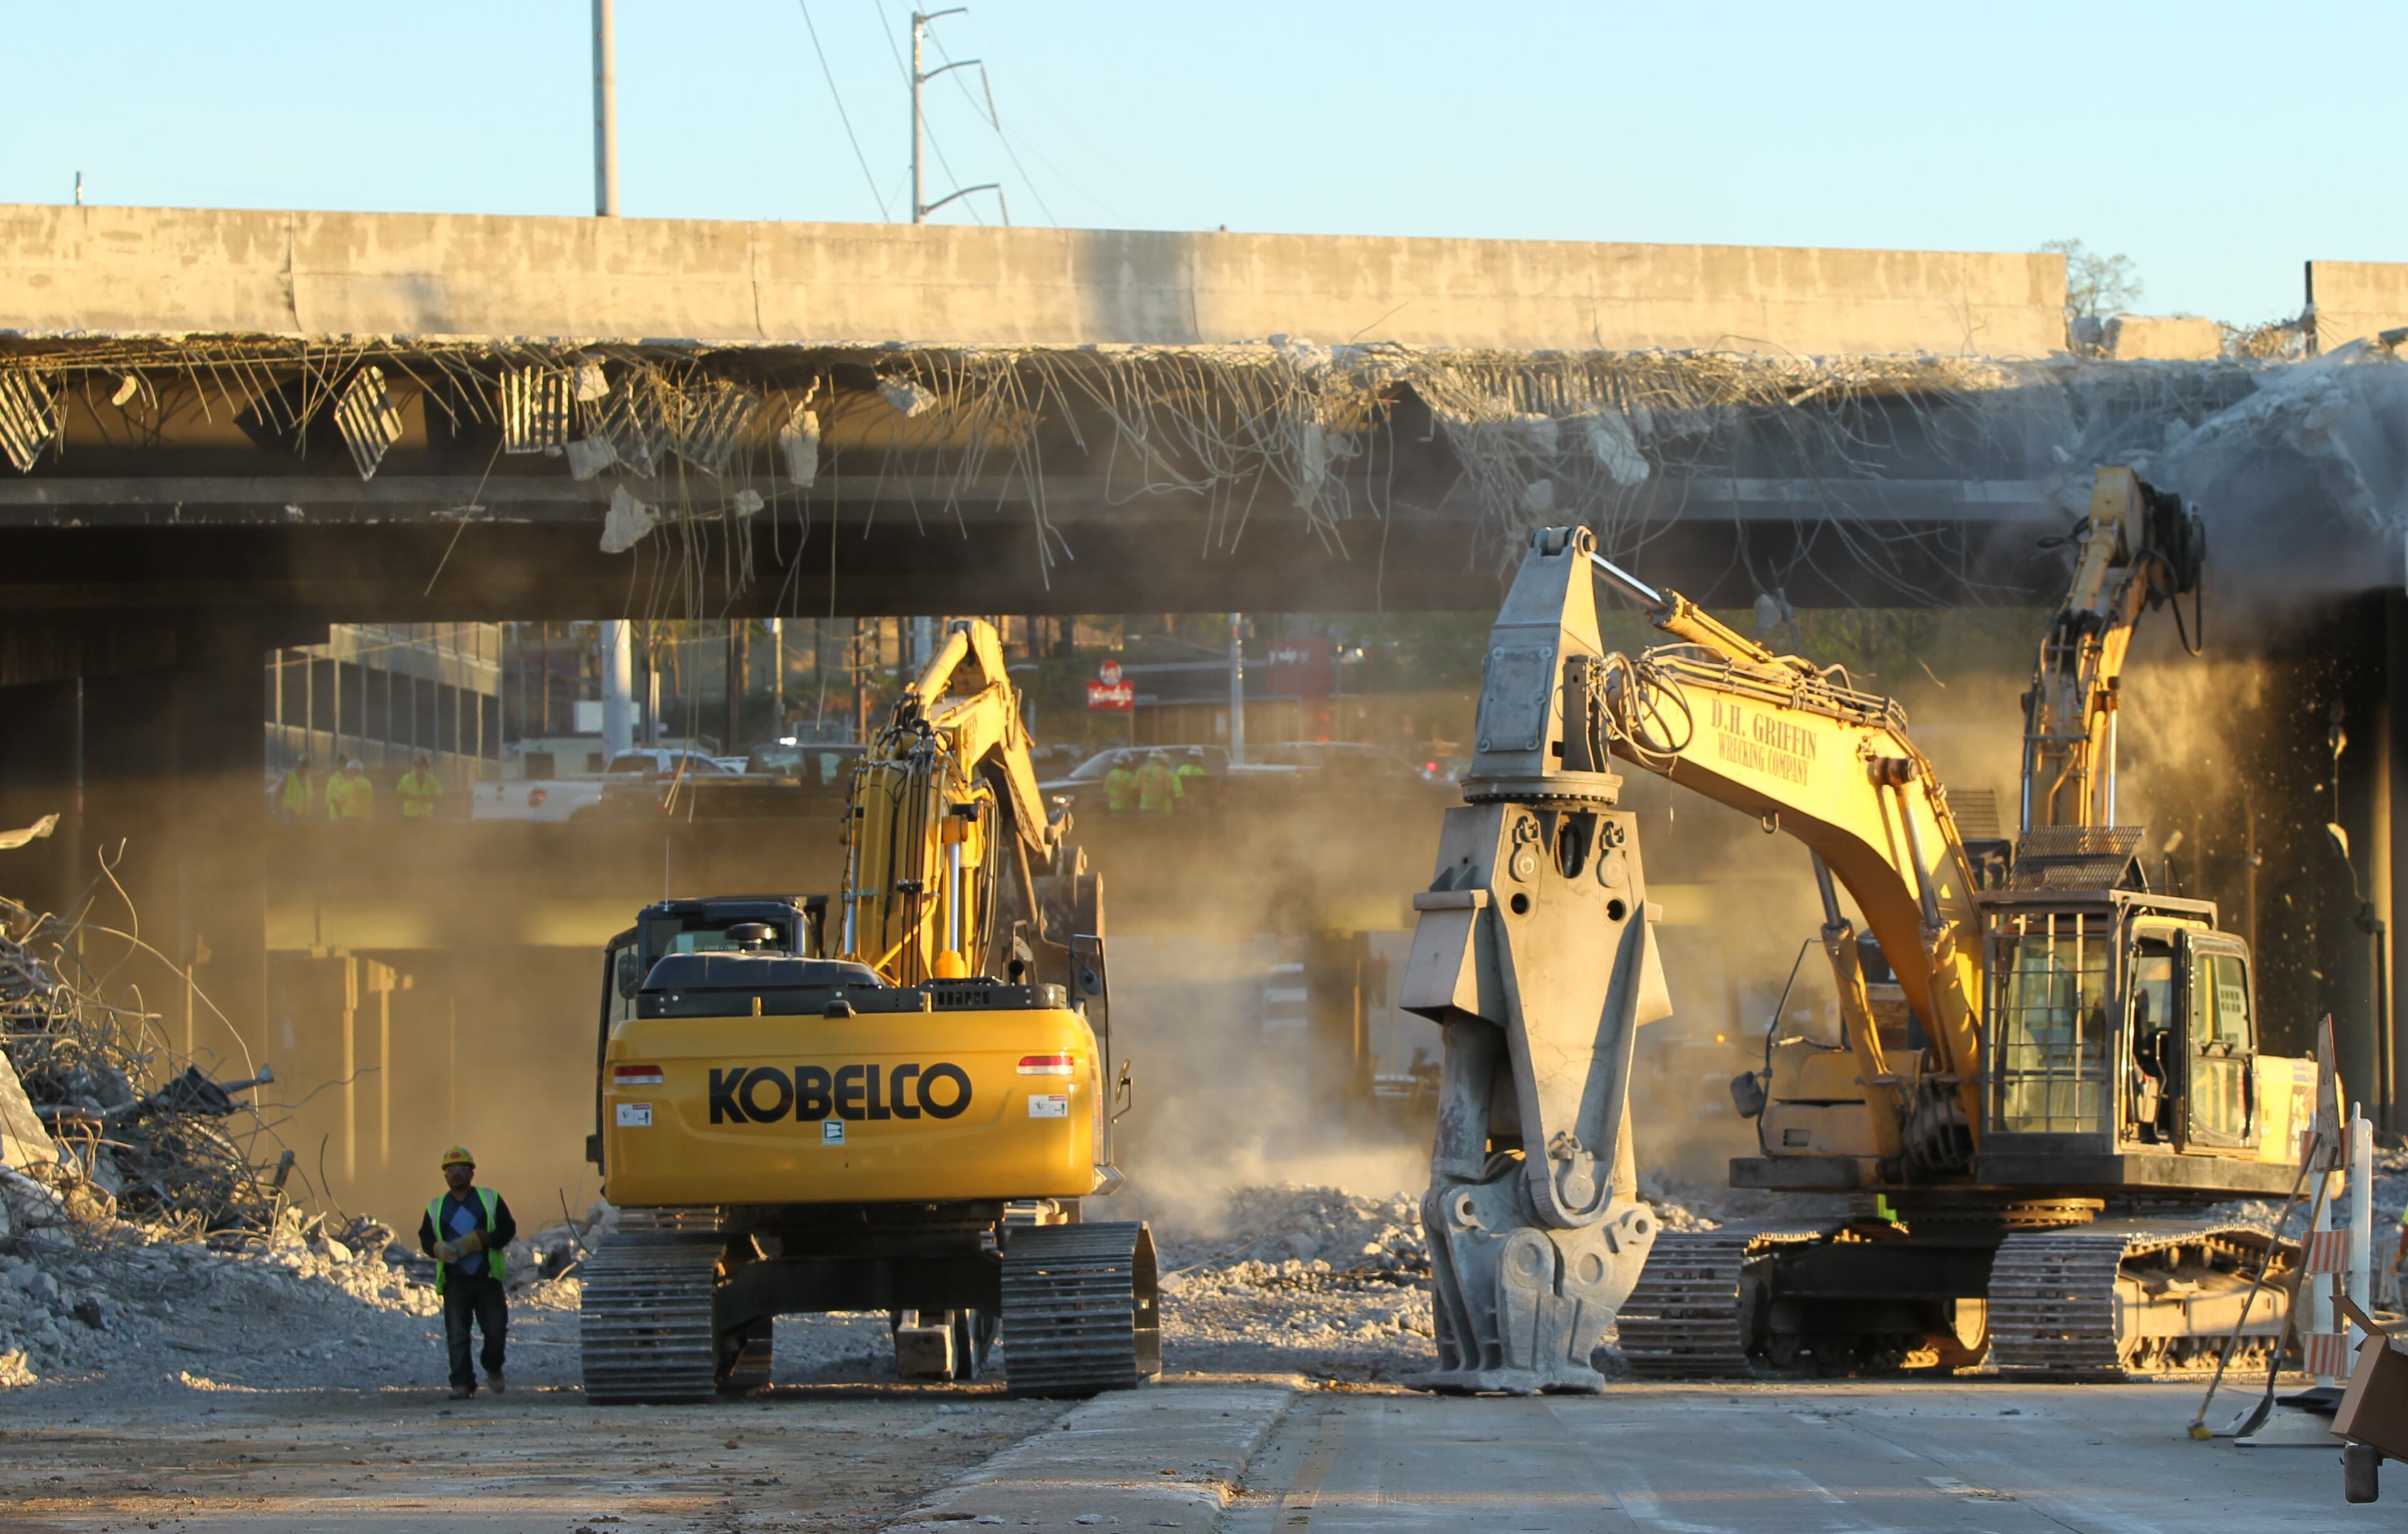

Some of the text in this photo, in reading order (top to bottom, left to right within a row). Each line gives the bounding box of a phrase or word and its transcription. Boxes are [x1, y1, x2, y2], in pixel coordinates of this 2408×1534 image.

[1711, 698, 1817, 761] D.H. GRIFFIN
[1718, 732, 1810, 786] WRECKING COMPANY
[709, 1062, 972, 1124] KOBELCO
